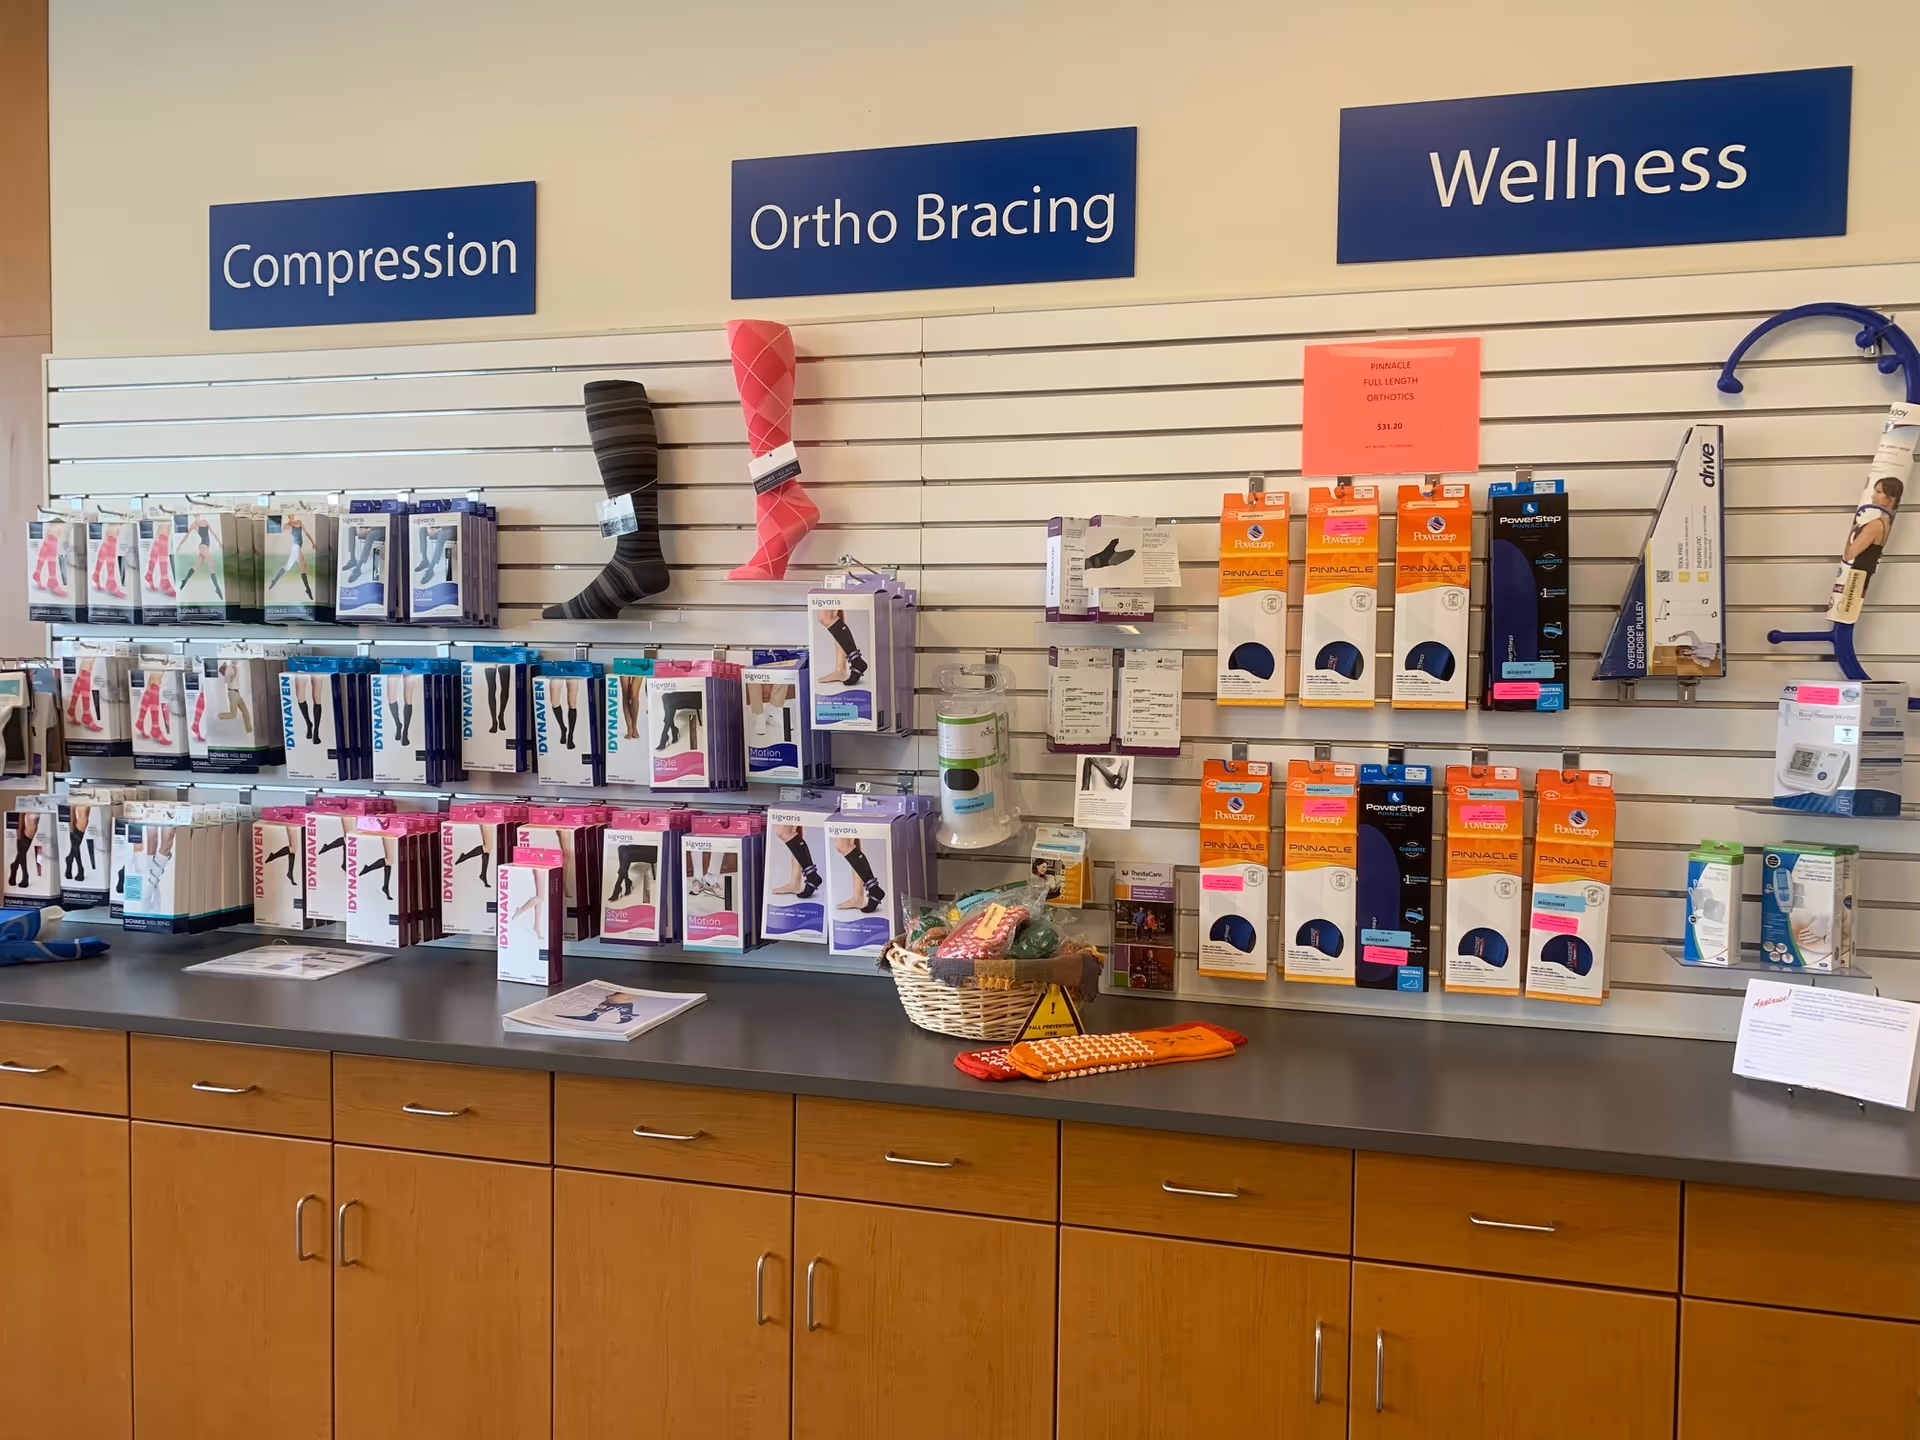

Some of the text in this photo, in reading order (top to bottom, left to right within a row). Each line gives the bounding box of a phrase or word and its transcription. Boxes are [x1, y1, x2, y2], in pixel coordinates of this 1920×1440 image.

[1429, 138, 1748, 208] Wellness
[750, 185, 1115, 251] Ortho Bracing
[223, 231, 517, 297] Compression
[1370, 361, 1412, 371] PINNACLE
[1363, 376, 1418, 387] FULL LENGTH
[1366, 392, 1415, 402] ORTHOTICS
[1377, 422, 1403, 431] $31.20
[1699, 442, 1715, 488] drive
[1499, 515, 1562, 525] PowerStep
[1322, 534, 1364, 546] Powerstep
[1413, 531, 1457, 543] Powerstep
[1234, 539, 1275, 550] Powerstep
[1222, 570, 1285, 578] PINNACLE
[1308, 565, 1374, 574] PINNACLE
[1400, 564, 1467, 572] PINNACLE
[811, 597, 841, 607] sigvaris
[1636, 600, 1644, 669] EXERCISE PULLEY
[1627, 625, 1635, 671] OVERDOOR
[744, 672, 770, 681] sigvaris
[650, 682, 677, 691] sigvaris
[462, 664, 473, 738] DYNAVEN
[281, 676, 296, 748] DYNAVEN
[373, 677, 384, 750] DYNAVEN
[534, 680, 549, 753] DYNAVEN
[608, 677, 618, 751] DYNAVEN
[750, 748, 781, 757] Motion
[654, 757, 677, 770] Style
[1365, 803, 1426, 813] PowerStep
[771, 813, 801, 823] sigvaris
[1214, 810, 1255, 822] Powerstep
[1300, 813, 1343, 826] Powerstep
[828, 825, 858, 835] sigvaris
[1554, 823, 1599, 838] Powerstep
[607, 832, 633, 841] sigvaris
[685, 840, 712, 849] sigvaris
[1203, 841, 1265, 851] PINNACLE
[1288, 844, 1353, 854] PINNACLE
[307, 817, 317, 890] DYNAVEN
[1451, 850, 1519, 860] PINNACLE
[254, 826, 264, 898] DYNAVEN
[443, 826, 453, 902] DYNAVEN
[1539, 855, 1608, 868] PINNACLE
[348, 836, 357, 913] DYNAVEN
[499, 869, 509, 948] DYNAVEN
[606, 909, 629, 919] Style
[688, 916, 721, 926] Motion
[1752, 989, 1793, 1009] Applause!
